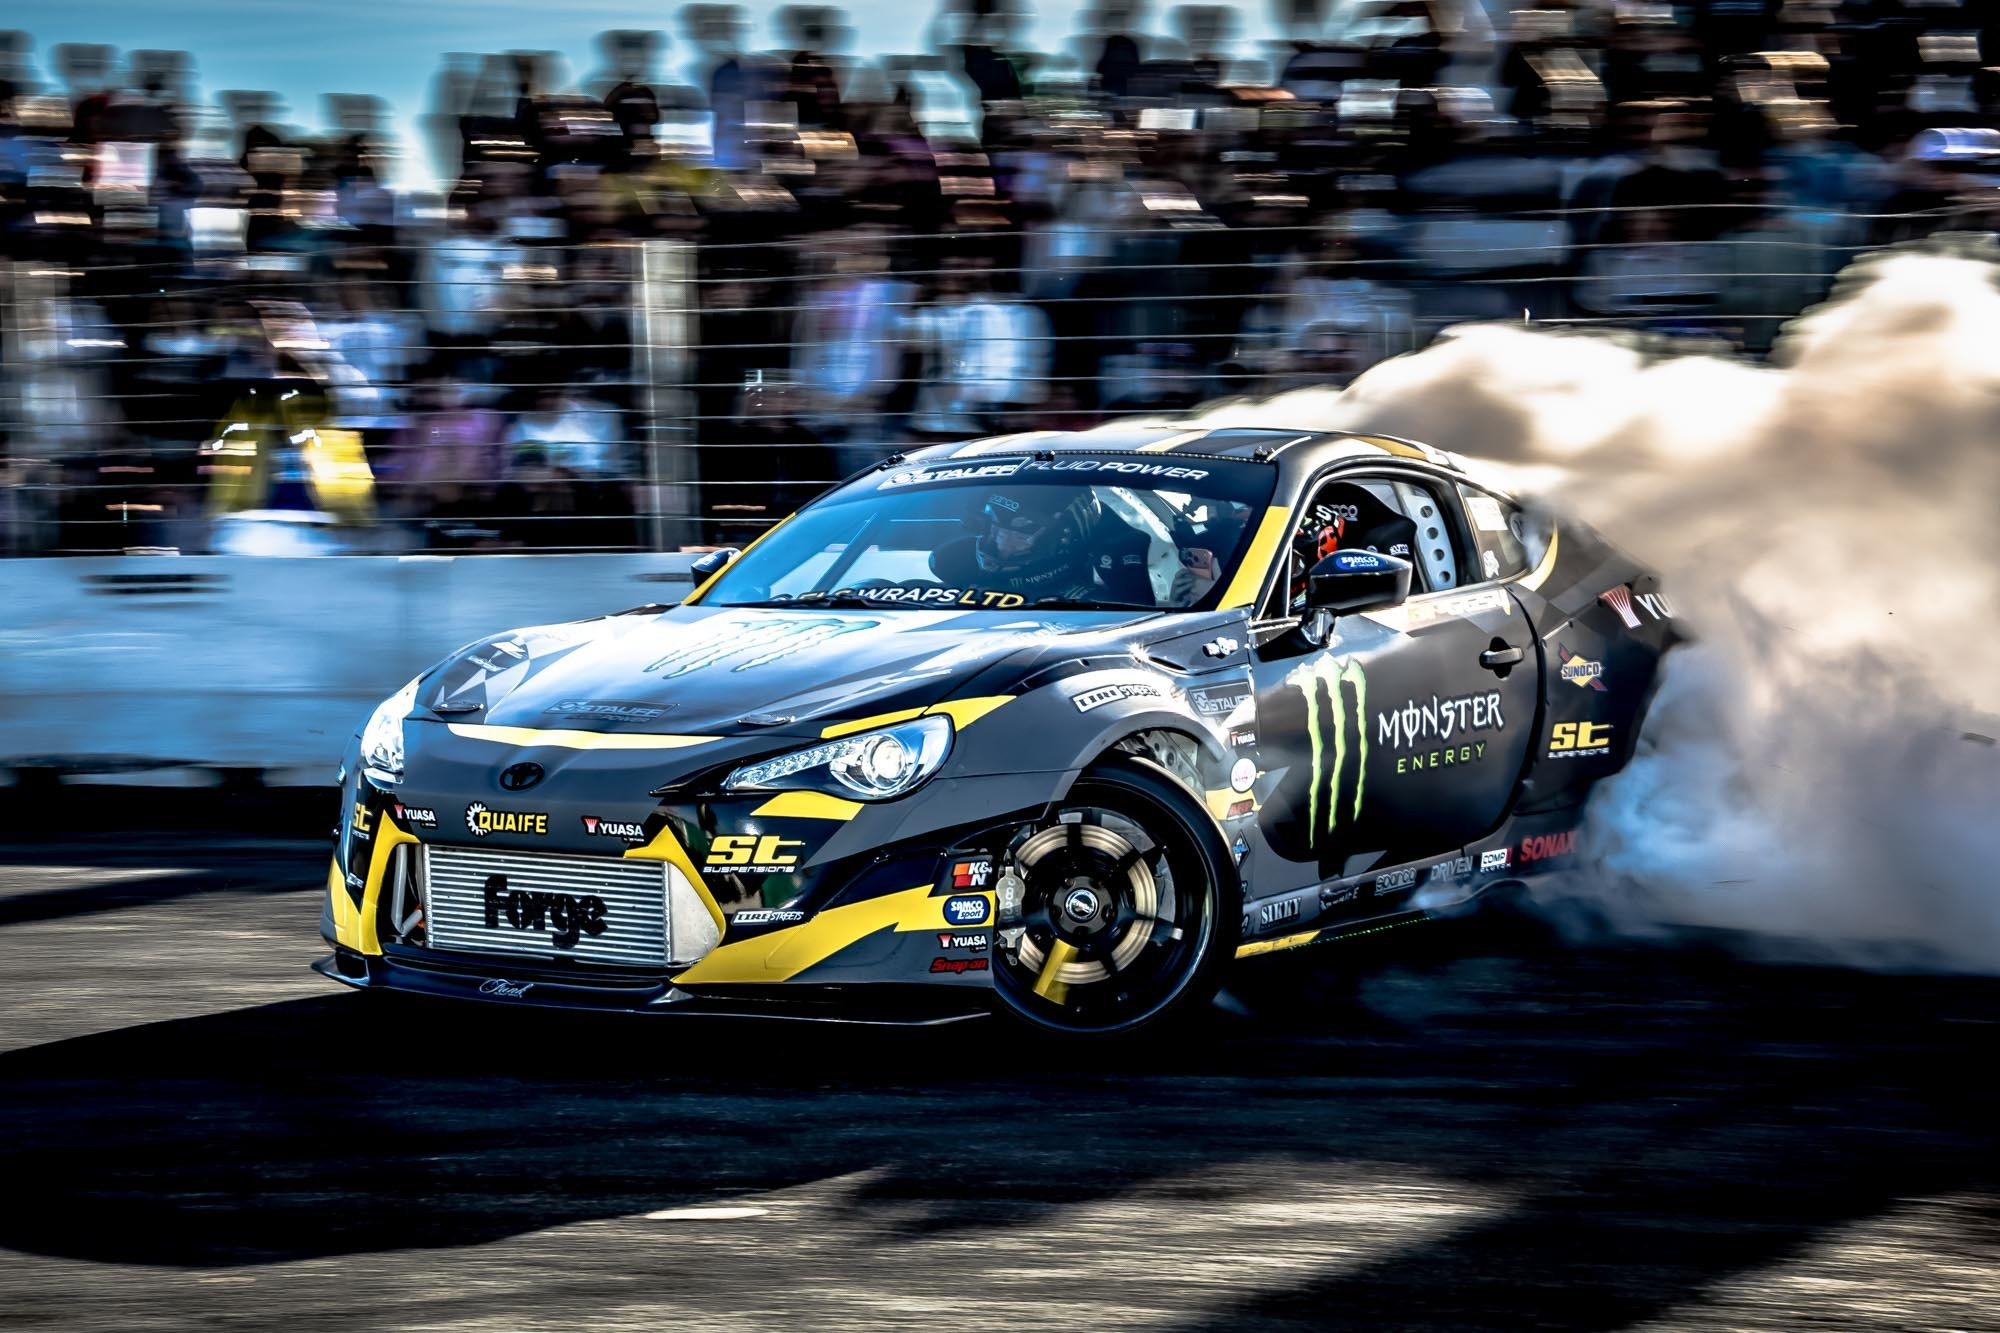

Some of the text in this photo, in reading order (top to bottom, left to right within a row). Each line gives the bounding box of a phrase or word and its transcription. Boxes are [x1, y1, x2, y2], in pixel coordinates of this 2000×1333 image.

[1023, 460, 1099, 471] FLUID
[1098, 461, 1210, 480] POWER
[857, 588, 958, 603] WRAPS
[959, 589, 1025, 608] LTD
[1562, 663, 1600, 678] SUNOCO
[1378, 692, 1504, 749] MONSTER
[1397, 743, 1485, 773] ENERGY
[404, 808, 436, 822] YUASA
[478, 810, 547, 833] QUAIFE
[600, 822, 644, 837] YUASA
[1430, 855, 1473, 882] DRIVEN
[950, 900, 984, 912] SAMCO
[960, 909, 983, 919] sport
[1261, 897, 1302, 925] SIKKY
[735, 910, 773, 923] TIRE
[952, 935, 987, 947] YUASA
